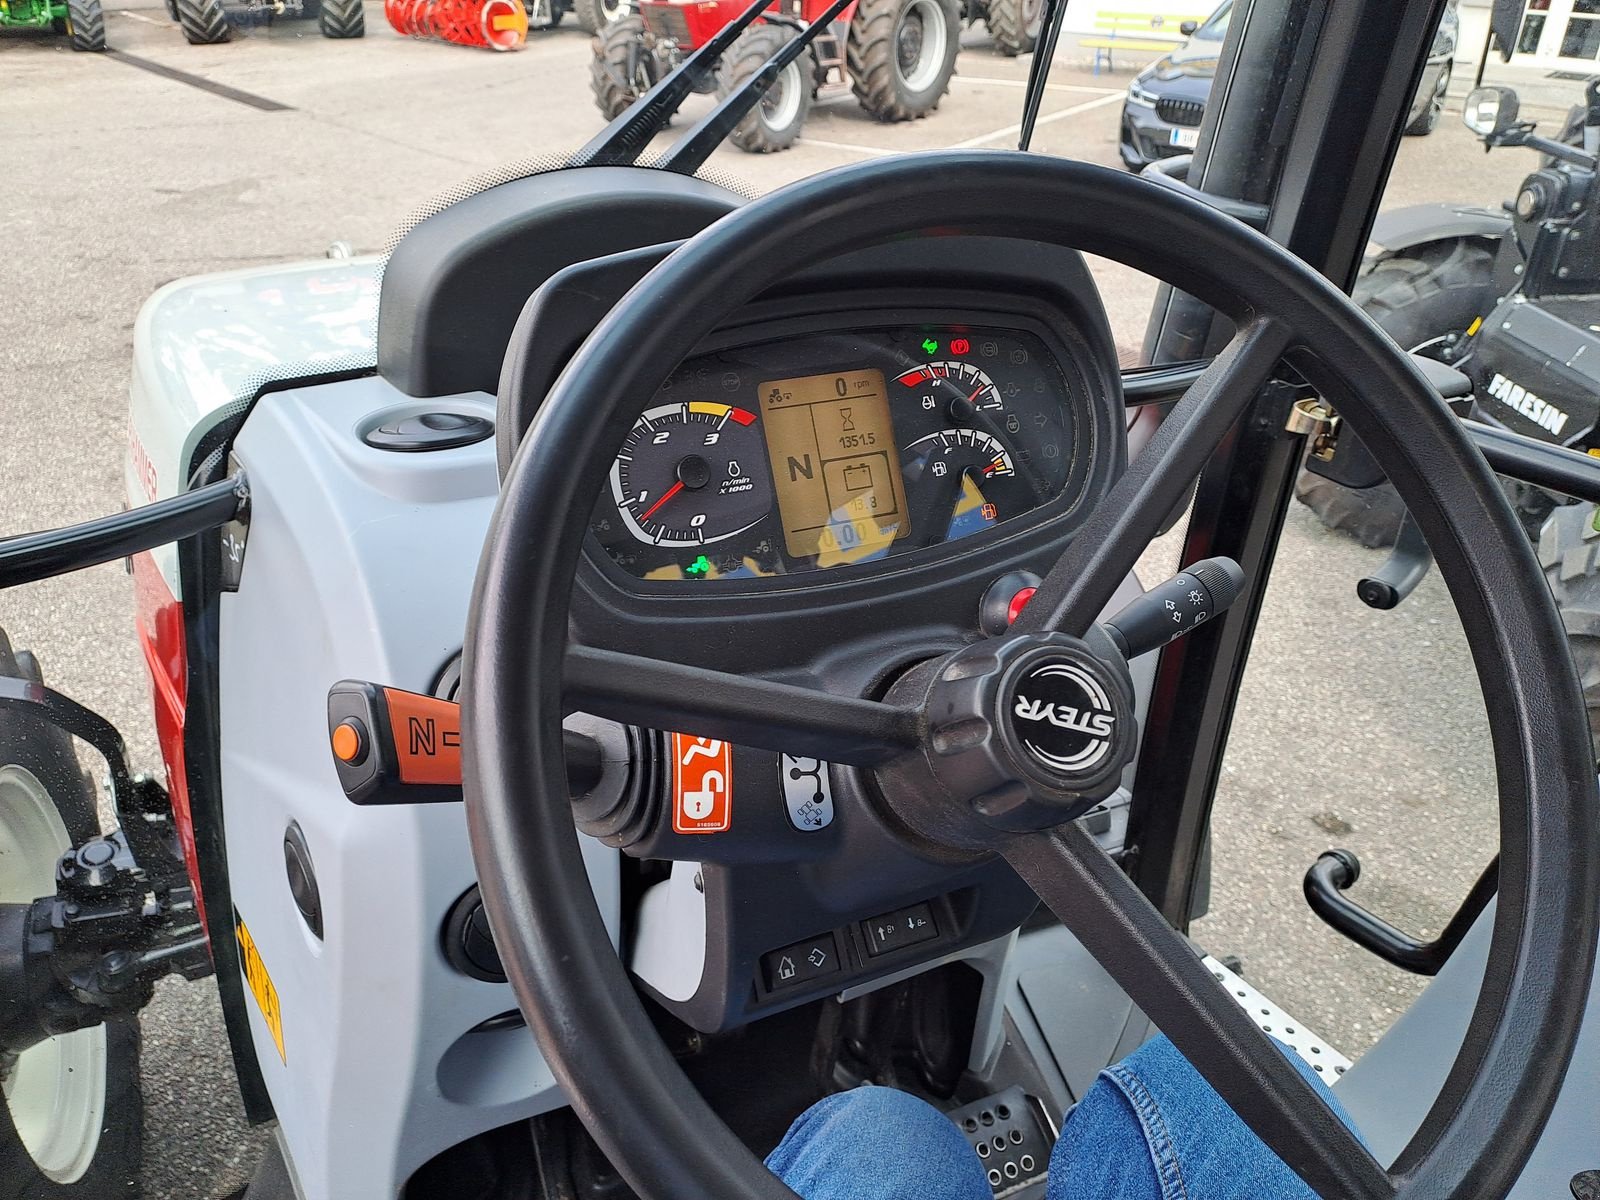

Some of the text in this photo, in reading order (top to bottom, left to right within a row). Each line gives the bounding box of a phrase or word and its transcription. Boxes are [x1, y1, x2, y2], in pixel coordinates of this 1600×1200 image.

[835, 377, 870, 397] 0 rpm
[1487, 373, 1569, 436] FARESIN
[652, 431, 670, 445] 2
[703, 433, 720, 446] 3
[839, 432, 876, 449] 1351.5
[787, 454, 814, 482] N
[721, 476, 750, 487] n/min
[728, 483, 753, 493] 1000
[638, 490, 648, 502] 1
[690, 513, 706, 527] 0
[1014, 695, 1116, 737] STEYR
[408, 716, 436, 756] N
